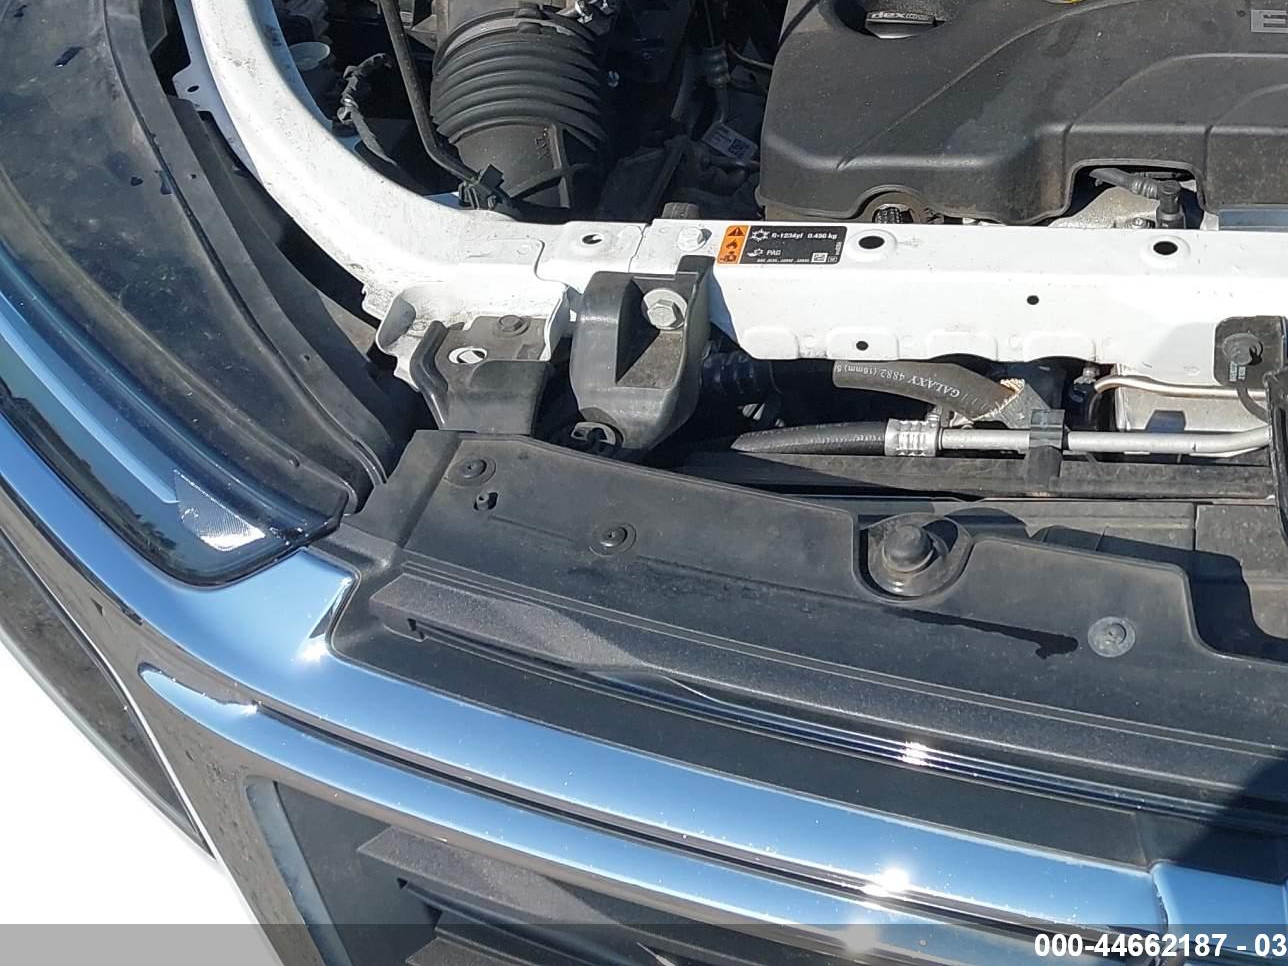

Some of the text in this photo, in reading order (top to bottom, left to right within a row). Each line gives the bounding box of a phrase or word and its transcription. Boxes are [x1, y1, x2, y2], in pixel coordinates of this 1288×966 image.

[845, 364, 877, 375] (16mm)
[880, 369, 905, 381] 4882
[908, 375, 960, 398] GALAXY
